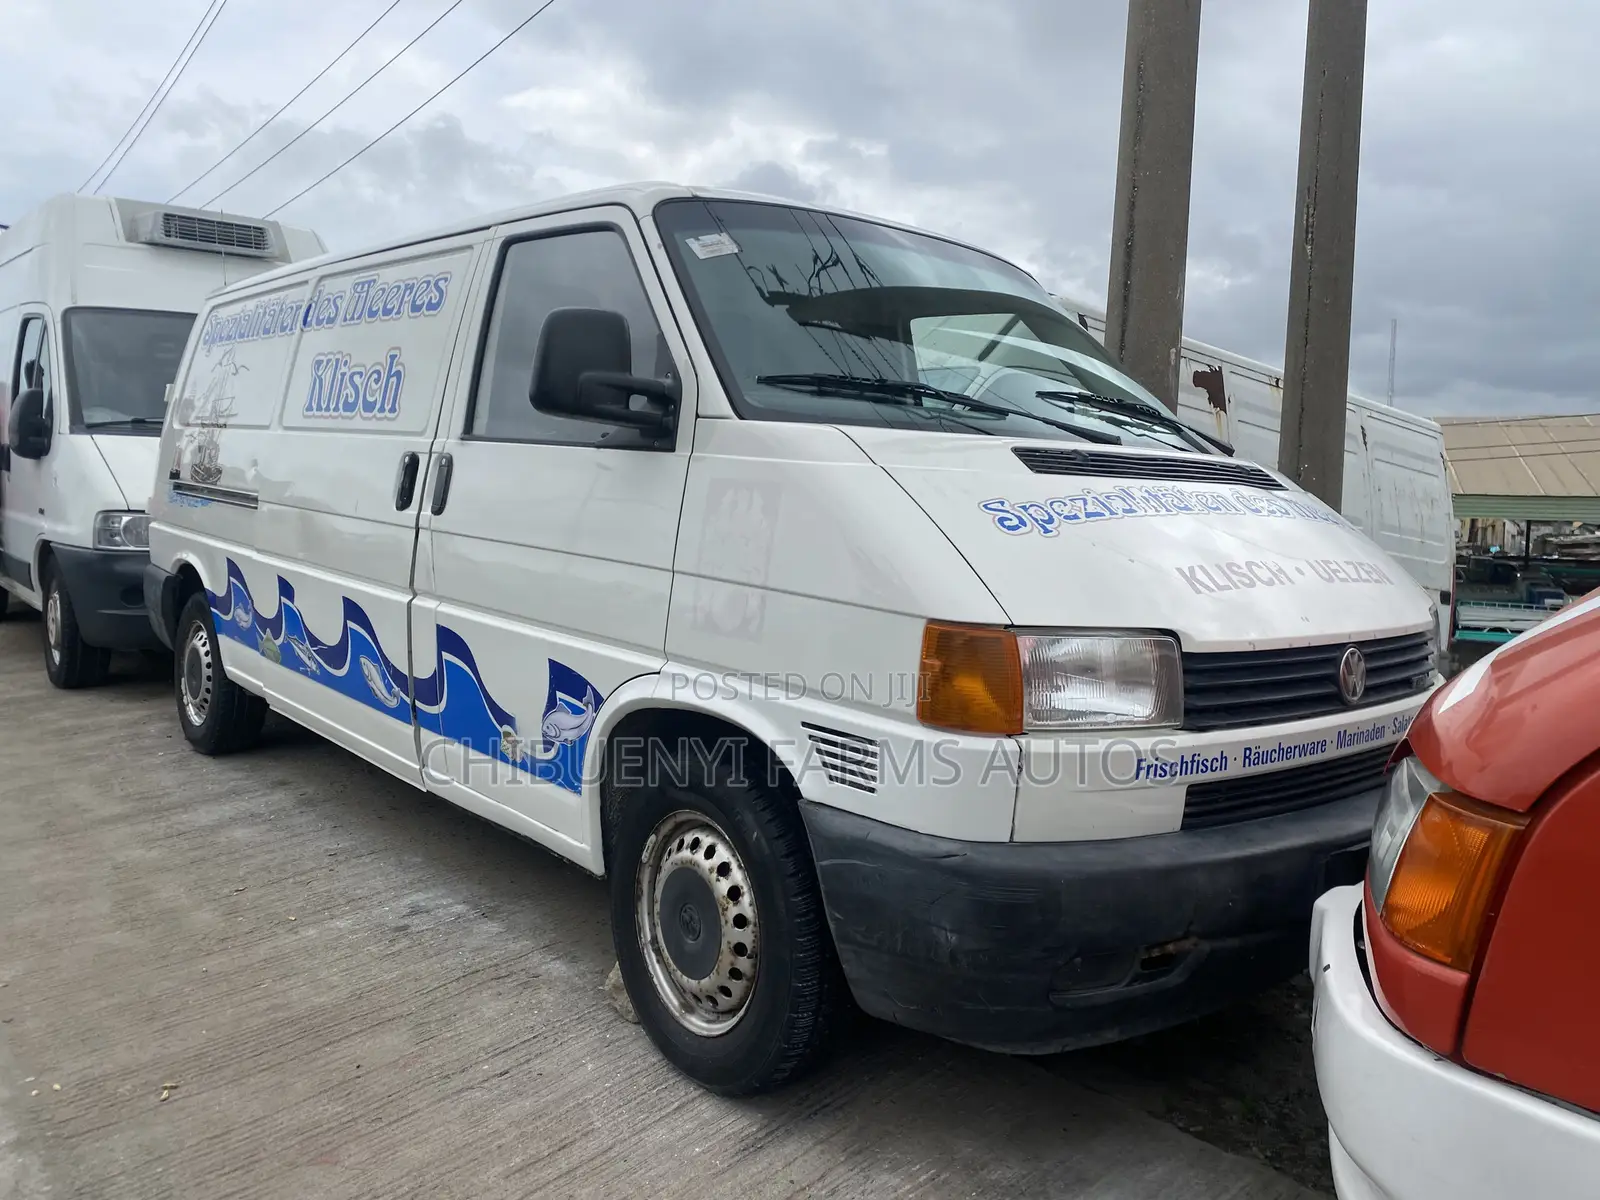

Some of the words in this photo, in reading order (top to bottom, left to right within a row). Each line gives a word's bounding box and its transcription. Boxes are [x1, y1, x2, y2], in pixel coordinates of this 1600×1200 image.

[302, 285, 345, 331] des
[342, 272, 451, 326] Meeres
[303, 348, 404, 420] Klisch
[979, 485, 1245, 536] Spezialitäten
[1175, 560, 1296, 595] KLISCH
[1304, 559, 1395, 586] UELZEN
[1135, 750, 1229, 782] Frischfisch
[1242, 736, 1327, 767] Räucherware
[1336, 722, 1386, 750] Marinaden
